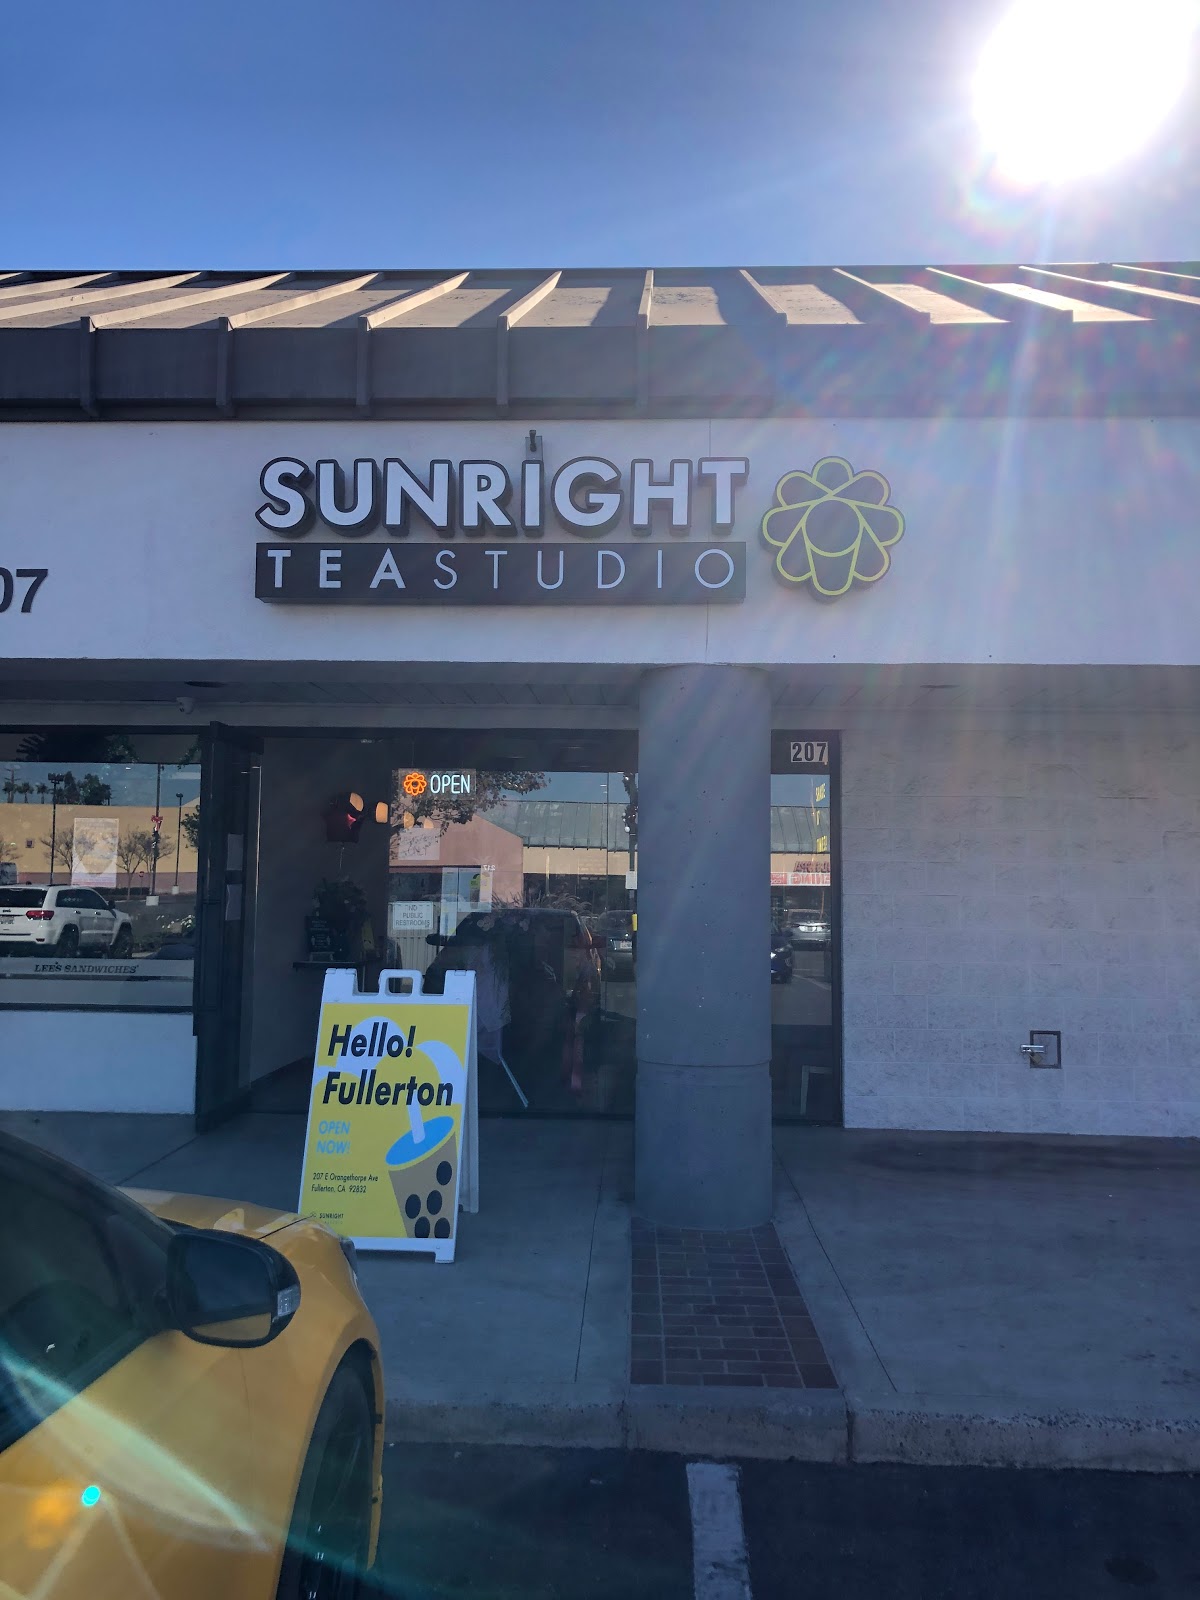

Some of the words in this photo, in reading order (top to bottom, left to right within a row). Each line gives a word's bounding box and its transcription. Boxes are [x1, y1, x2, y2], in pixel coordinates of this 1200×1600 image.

[255, 456, 749, 538] SUNRIGHT
[792, 742, 827, 762] 207
[430, 774, 471, 794] OPEN
[64, 965, 137, 974] SANDWICHES
[327, 1022, 417, 1058] Hello!
[322, 1069, 454, 1106] Fullerton
[318, 1120, 351, 1135] OPEN
[316, 1139, 351, 1154] NOW!
[312, 1172, 324, 1181] 207
[325, 1173, 329, 1181] E
[329, 1173, 367, 1183] Orangethorpe
[367, 1174, 379, 1182] Ave
[337, 1184, 346, 1193] CA
[349, 1185, 367, 1194] 92832
